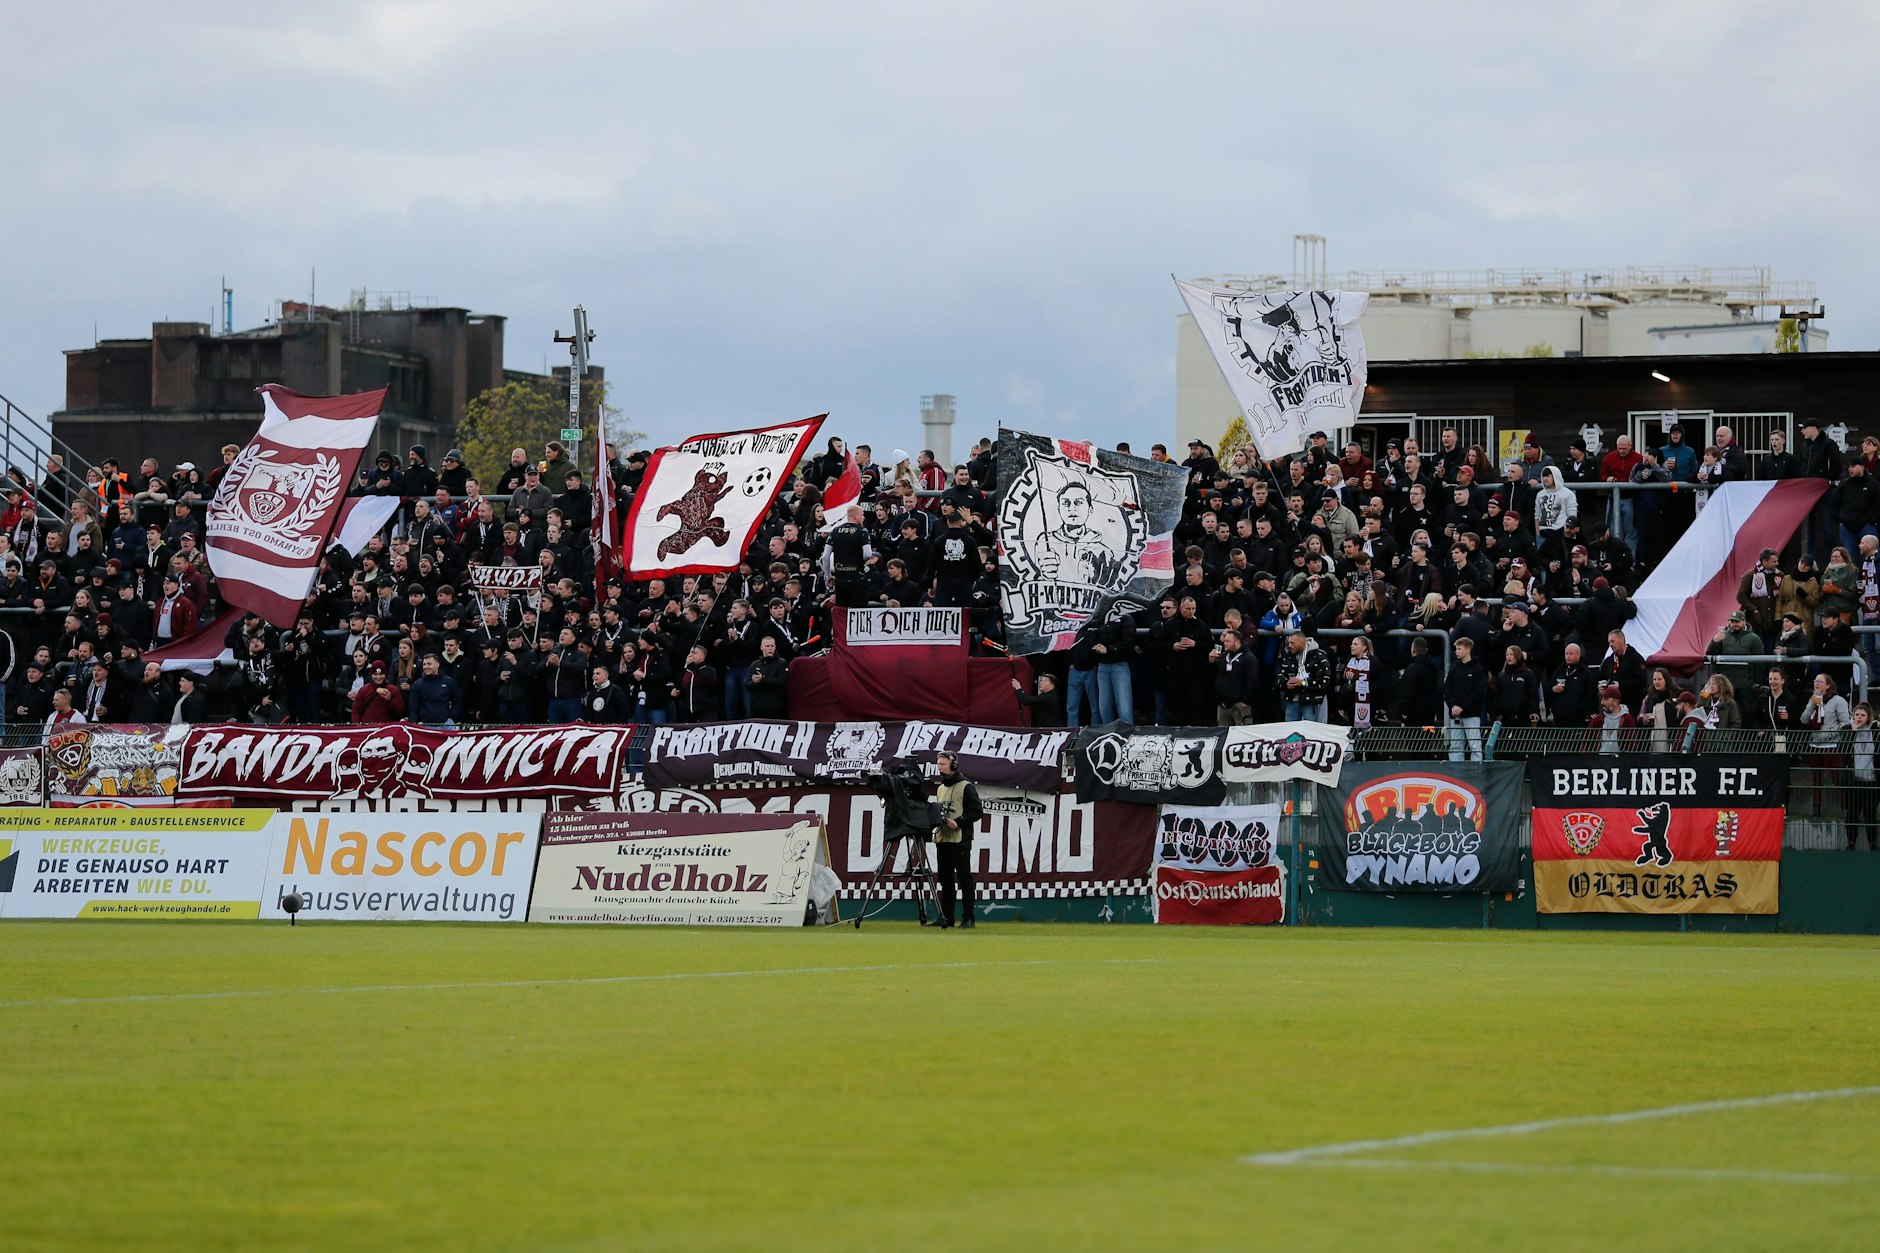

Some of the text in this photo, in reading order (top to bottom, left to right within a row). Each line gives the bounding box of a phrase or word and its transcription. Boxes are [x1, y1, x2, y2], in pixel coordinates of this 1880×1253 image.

[849, 610, 872, 637] FICK
[876, 608, 921, 636] DICH
[649, 720, 1071, 767] FRAKTION-H OST BERLIN
[183, 728, 616, 783] BANDA INVICTA
[713, 760, 796, 778] BERLINER FUSSBALL
[1552, 768, 1763, 796] BERLINER F.C.
[1363, 784, 1469, 818] BFC
[54, 817, 117, 826] REPARATUR
[130, 817, 246, 826] BAUSTELLENSERVICE
[550, 814, 584, 823] Ab hier
[560, 823, 598, 832] Minuten
[611, 821, 630, 829] Fuß
[1568, 813, 1600, 828] BFC
[548, 833, 594, 842] Falkenberger
[1347, 831, 1482, 855] BLACKBOYS
[42, 839, 166, 855] WERKZEUGE,
[282, 817, 526, 877] Nascor
[617, 843, 731, 860] Kiezgaststätte
[37, 858, 229, 874] DIE GENAUSO HART
[1346, 853, 1481, 885] DYNAMO
[33, 878, 212, 894] ARBEITEN WIE DU.
[572, 863, 768, 893] Nudelholz
[1568, 871, 1738, 900] OLDTRAS
[594, 895, 740, 905] Hausgemachte deutsche Küche
[92, 904, 231, 915] www.hack-werkzeughandel.de
[549, 913, 684, 922] www.nudelholz-berlin.com
[696, 915, 714, 923] Tel.
